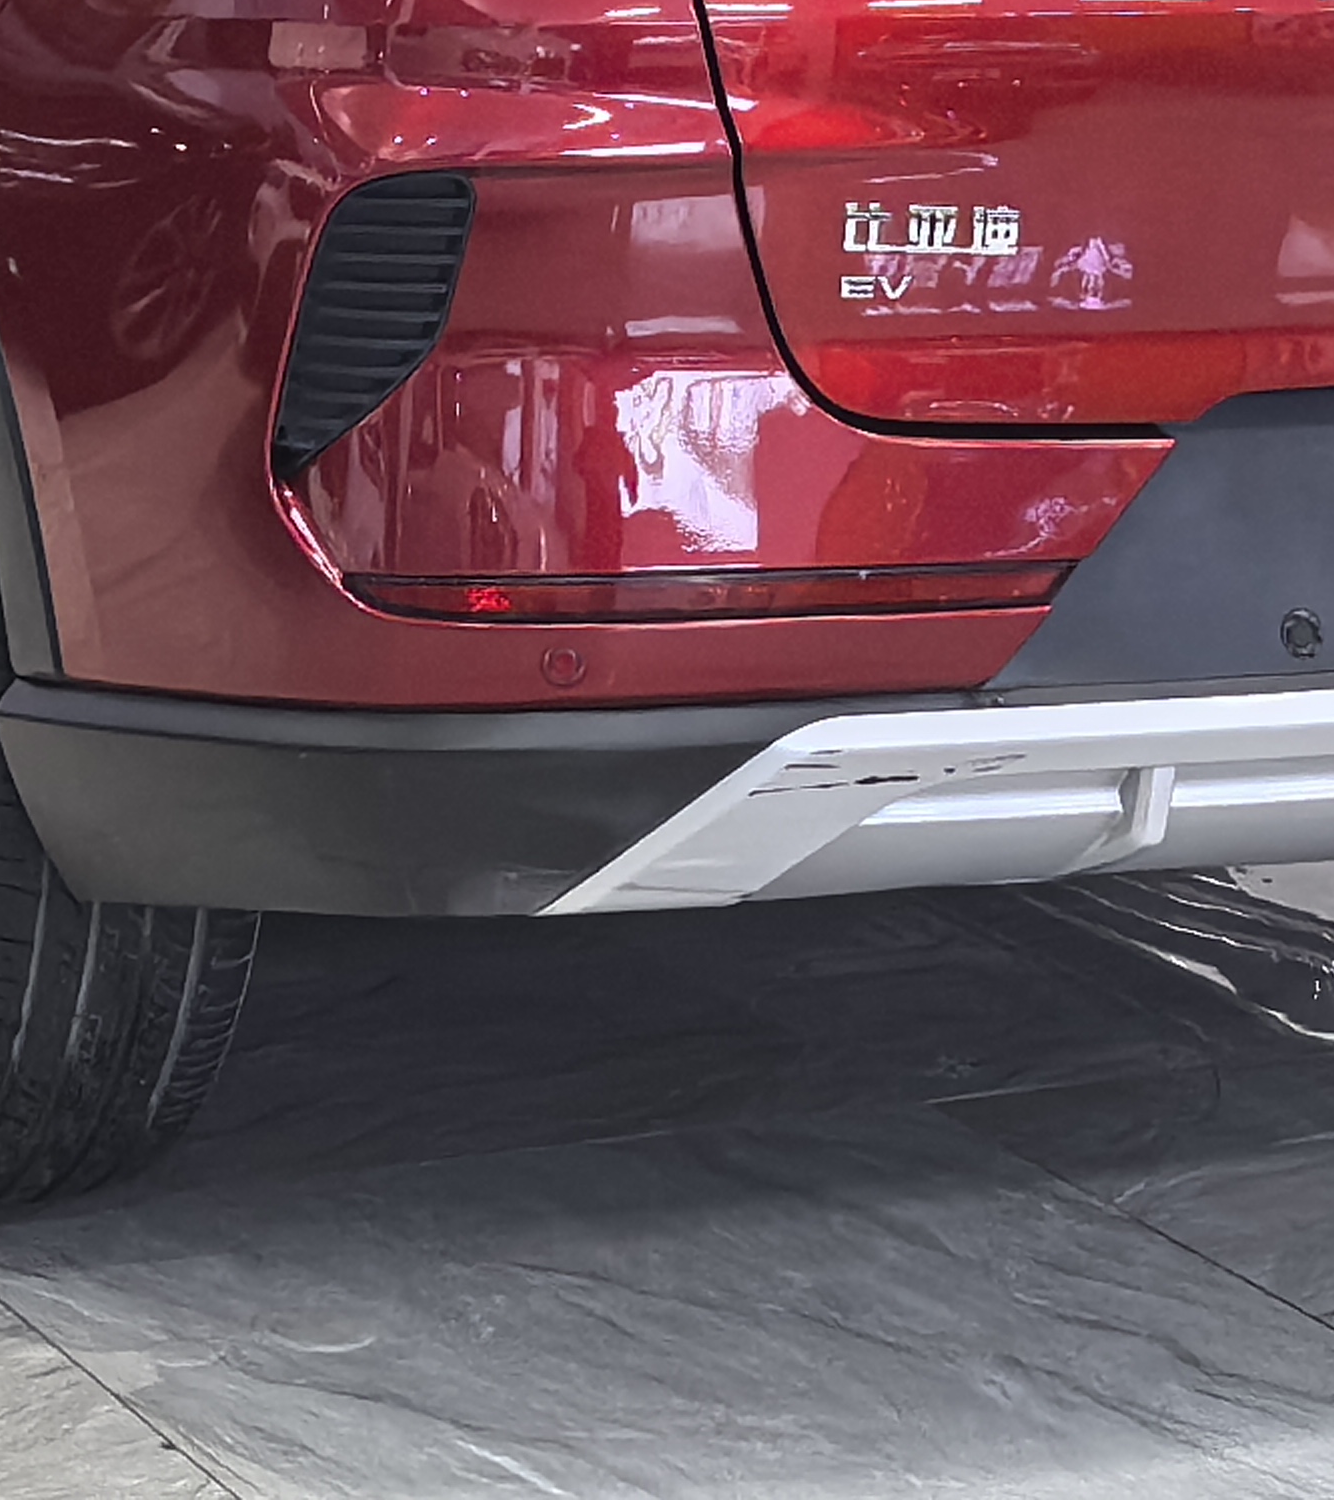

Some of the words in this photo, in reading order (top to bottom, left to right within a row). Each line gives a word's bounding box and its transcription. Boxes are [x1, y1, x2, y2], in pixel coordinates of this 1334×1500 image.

[843, 201, 1020, 255] 比亚迪
[840, 276, 913, 299] EV
